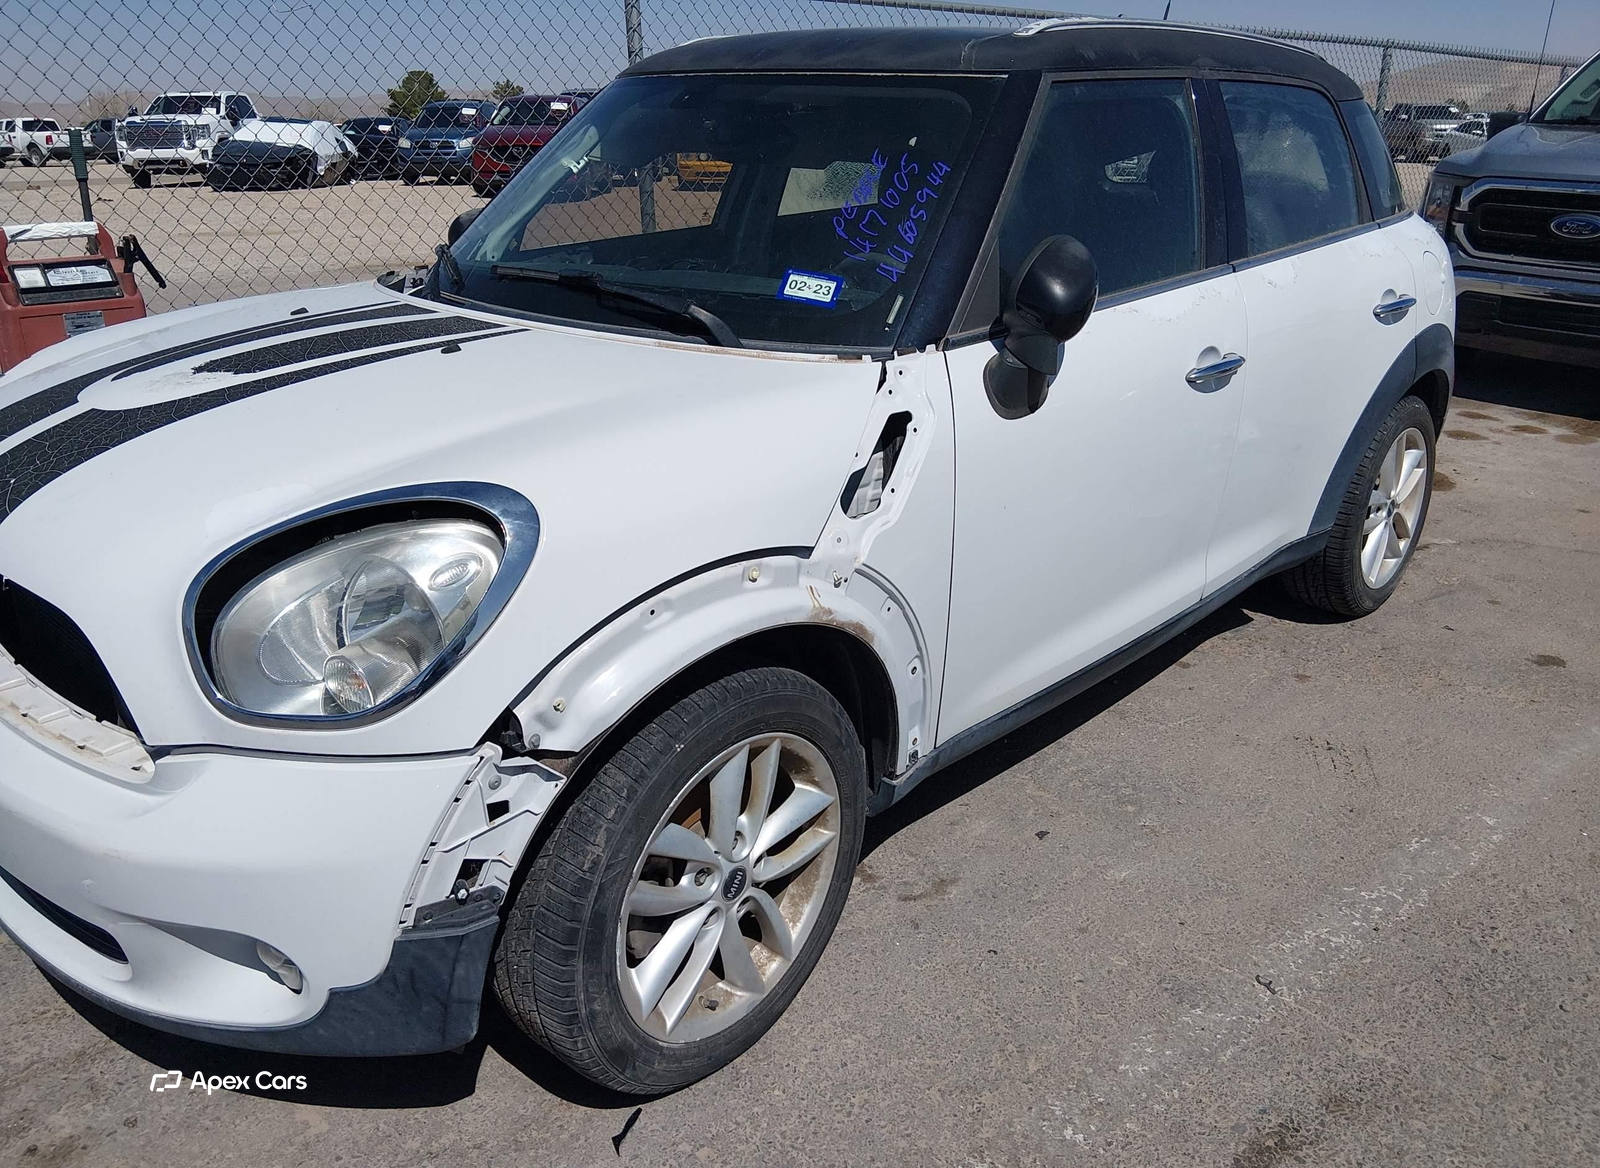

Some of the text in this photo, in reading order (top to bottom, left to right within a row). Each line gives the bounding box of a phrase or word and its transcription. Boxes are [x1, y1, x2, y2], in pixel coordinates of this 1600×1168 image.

[1562, 220, 1593, 234] Ford
[788, 279, 808, 292] 02
[812, 283, 832, 296] 23
[727, 871, 744, 898] MINI
